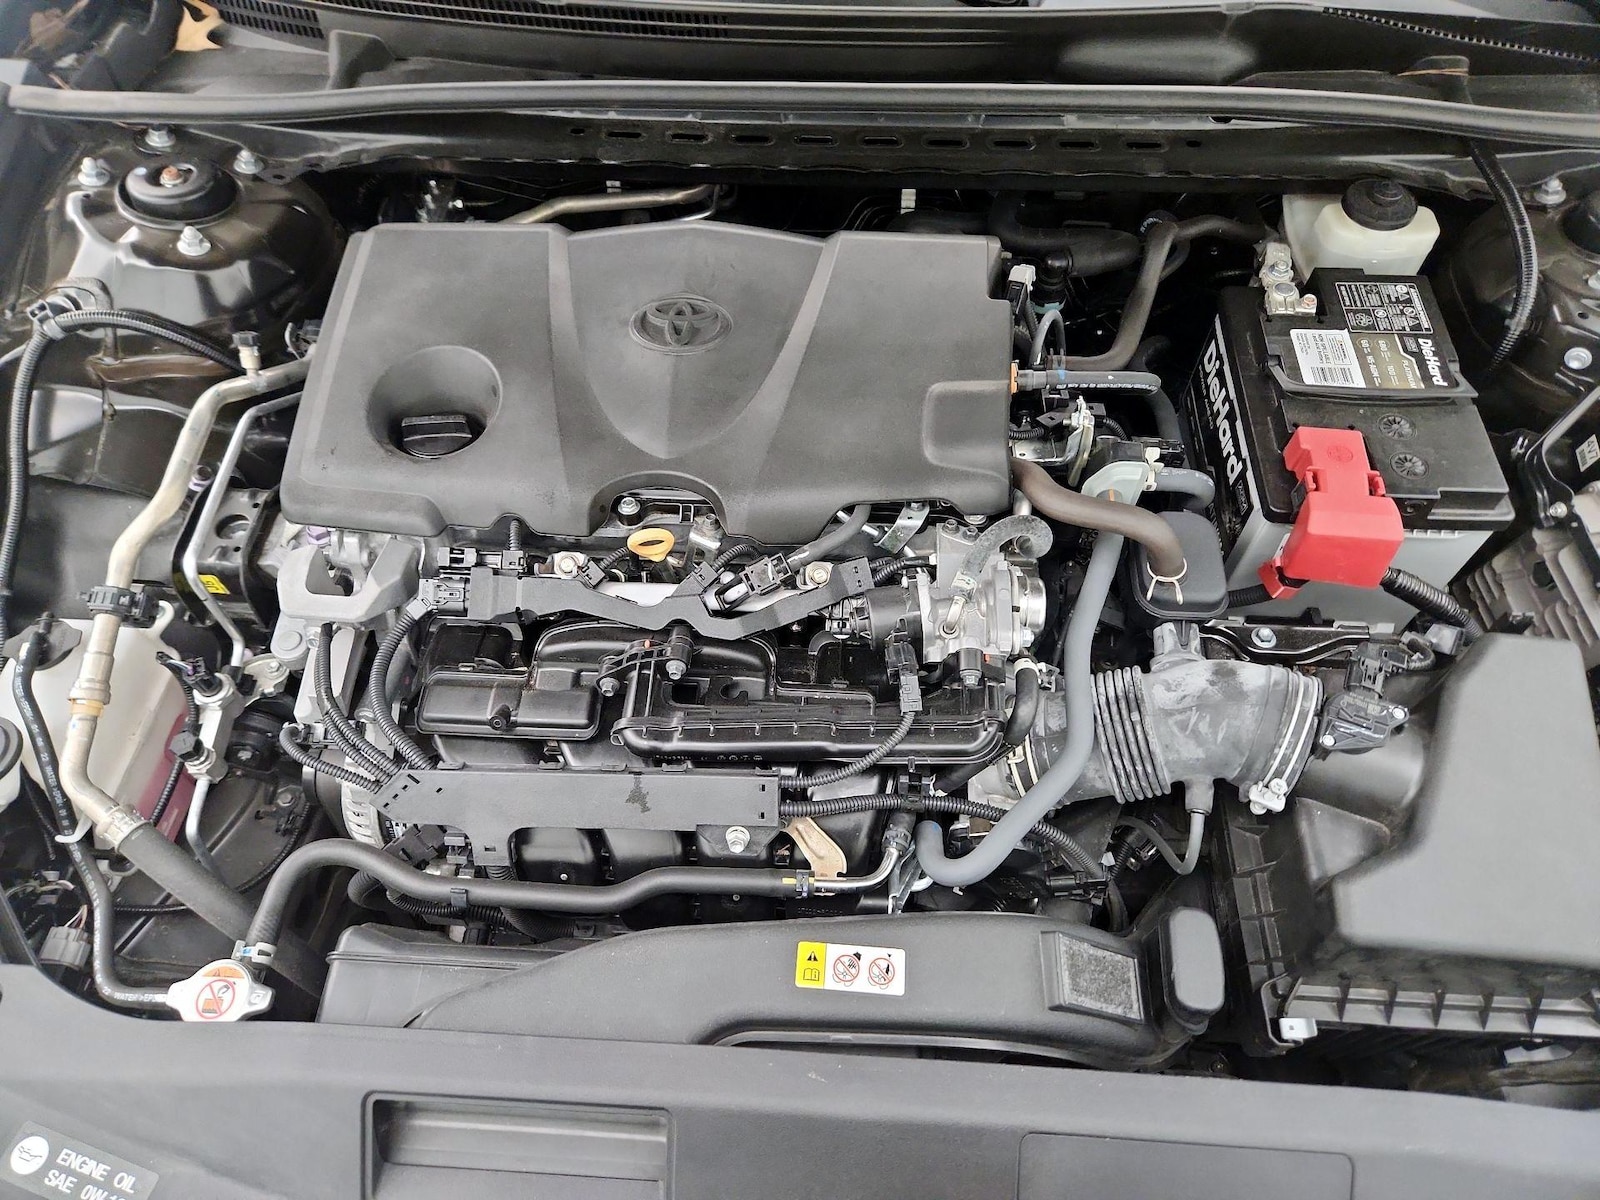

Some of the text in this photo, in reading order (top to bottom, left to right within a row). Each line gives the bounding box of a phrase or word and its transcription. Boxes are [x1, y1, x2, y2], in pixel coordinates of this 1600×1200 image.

[1418, 337, 1449, 387] DieHard
[1203, 339, 1243, 486] DieHard
[114, 992, 138, 1002] WATER
[44, 1169, 78, 1194] SAE
[56, 1148, 136, 1194] ENGINE OIL
